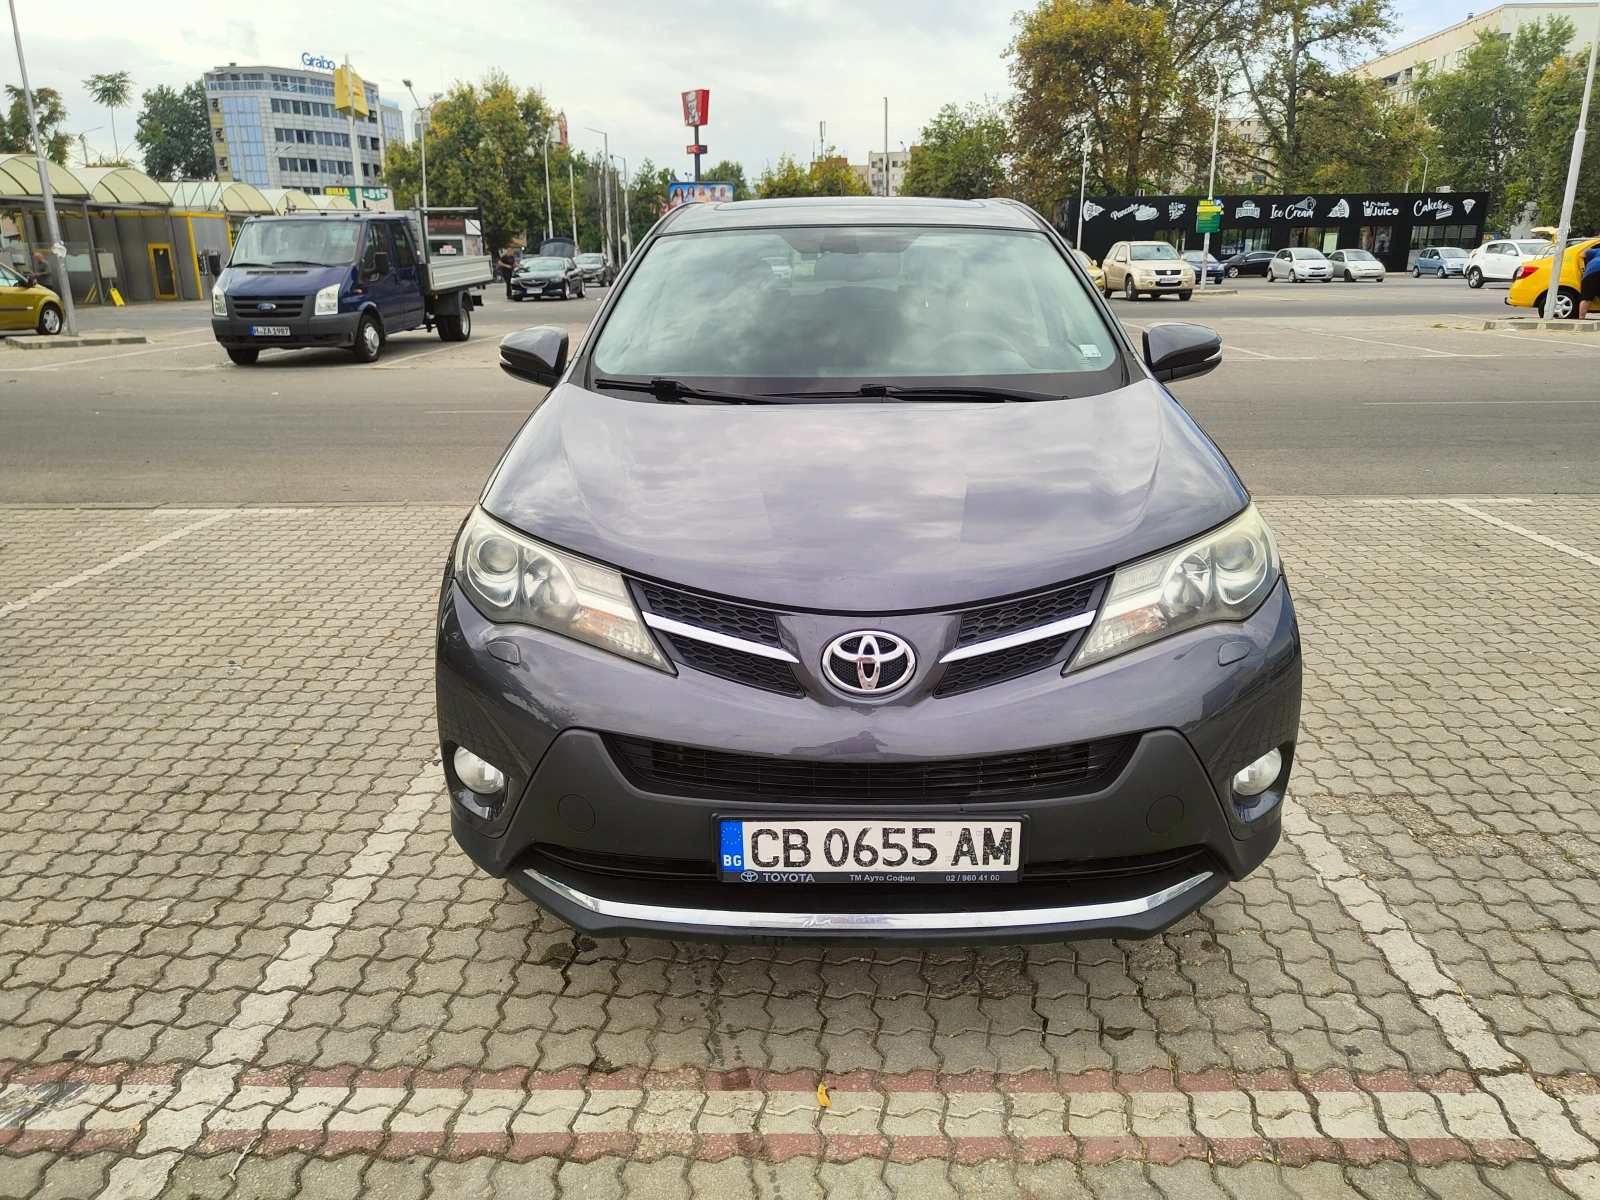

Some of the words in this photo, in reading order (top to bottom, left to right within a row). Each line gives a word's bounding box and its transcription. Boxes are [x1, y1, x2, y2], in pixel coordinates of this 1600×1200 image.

[302, 52, 336, 71] Grabo
[325, 187, 350, 196] BILLA
[1270, 204, 1284, 219] Ice
[1285, 203, 1315, 220] Cream
[1372, 206, 1399, 217] Juice
[1413, 197, 1444, 217] Cakes
[751, 827, 812, 868] CB
[823, 827, 939, 867] 0655
[950, 827, 1013, 867] AM
[723, 854, 742, 867] BG
[762, 872, 815, 882] TOYOTA
[863, 874, 884, 883] Ауто
[886, 874, 916, 883] София
[945, 874, 956, 882] 02
[962, 874, 976, 882] 960
[977, 874, 989, 882] 41
[990, 873, 1000, 882] 00
